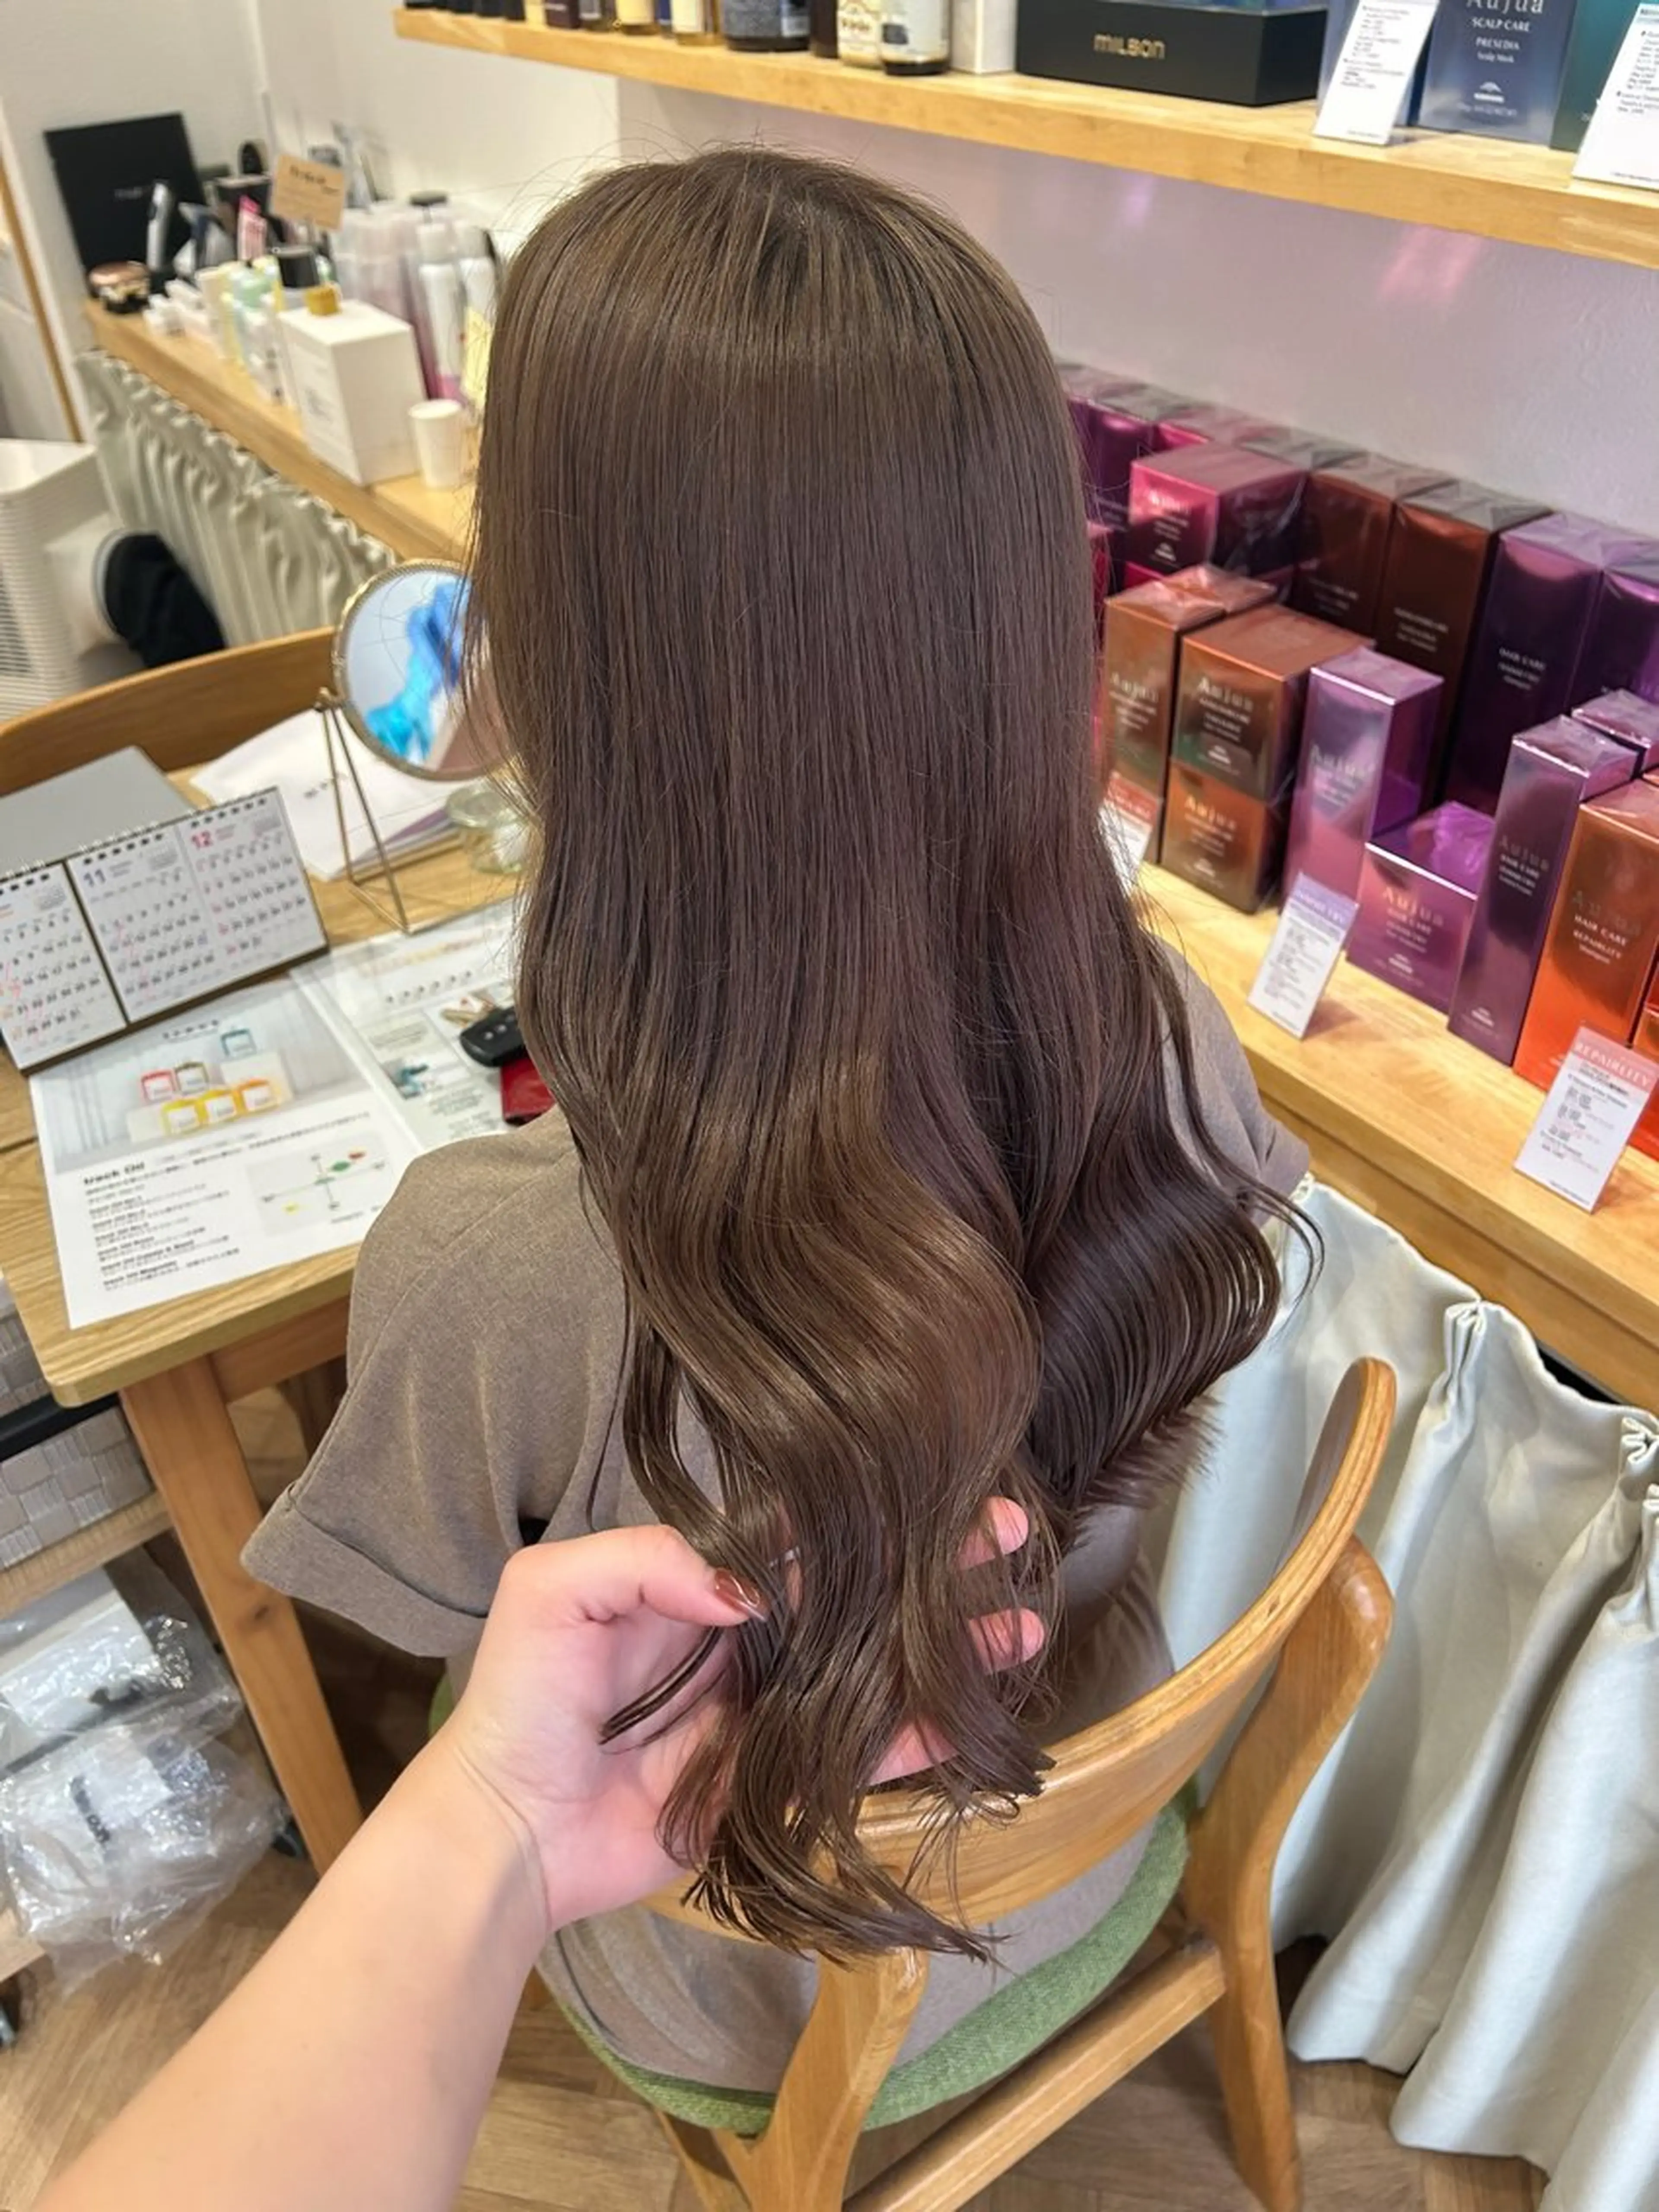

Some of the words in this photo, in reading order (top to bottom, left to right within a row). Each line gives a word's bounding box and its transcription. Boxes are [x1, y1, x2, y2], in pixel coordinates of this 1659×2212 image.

[1503, 19, 1530, 32] CARE
[191, 830, 213, 850] 12
[83, 869, 106, 887] 11
[1574, 913, 1598, 932] HAIR
[1600, 927, 1627, 947] CARE
